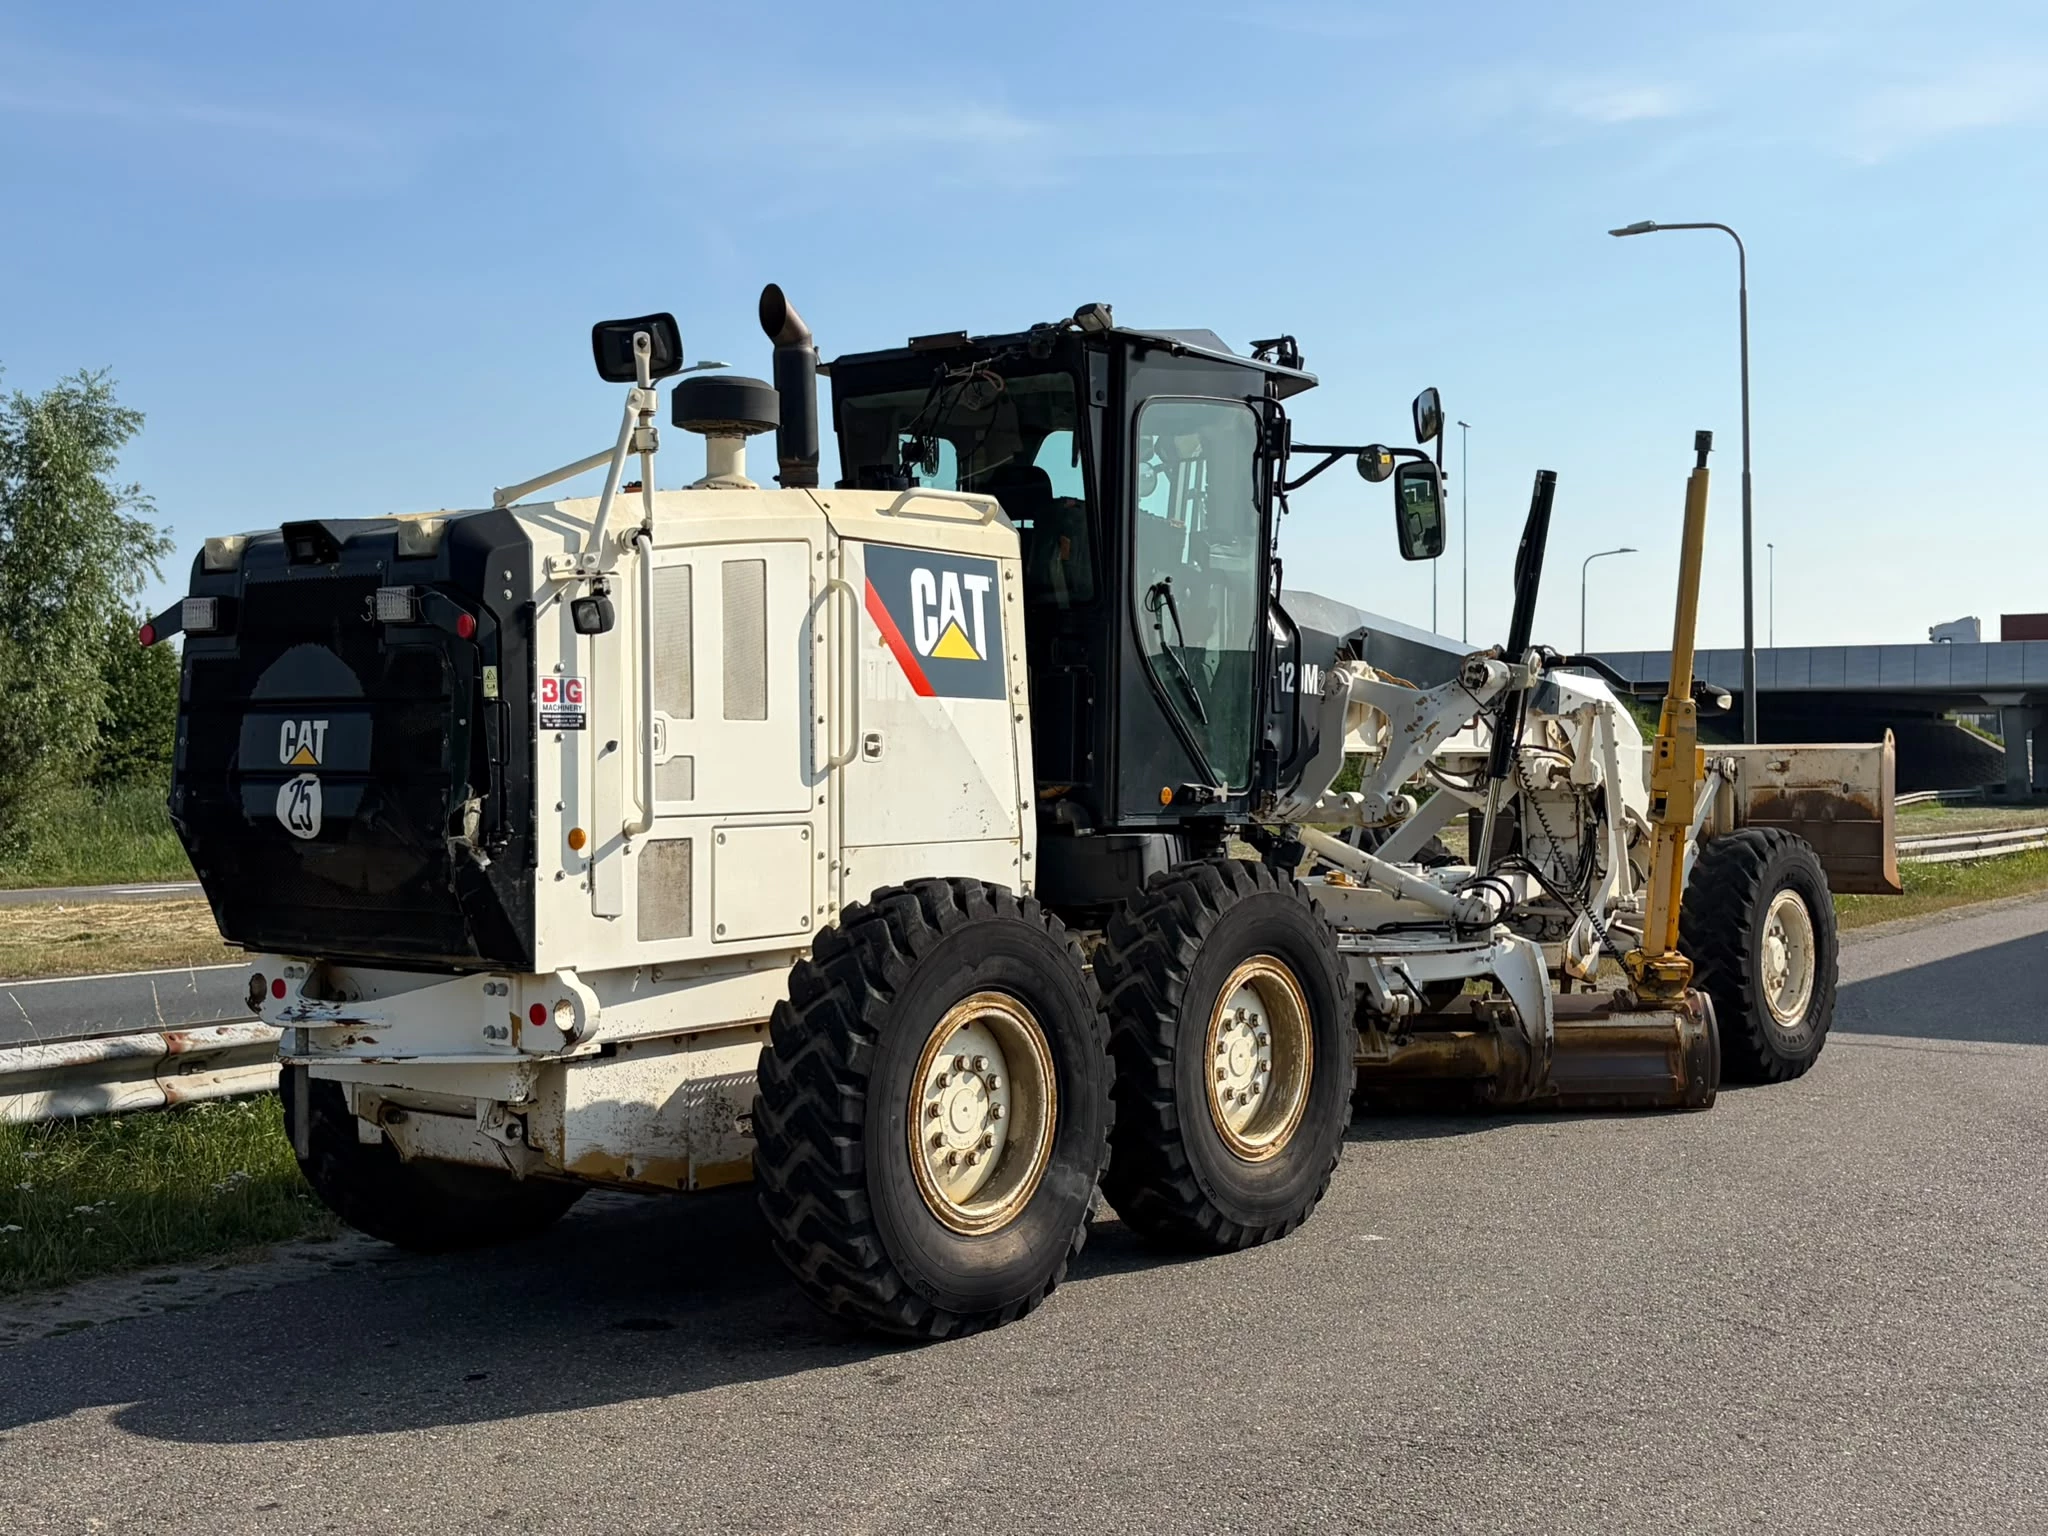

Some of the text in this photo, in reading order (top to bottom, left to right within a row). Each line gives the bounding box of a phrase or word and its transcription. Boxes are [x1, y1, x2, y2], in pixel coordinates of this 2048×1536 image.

[910, 567, 990, 661] CAT
[542, 678, 583, 703] BIG
[542, 704, 583, 712] MACHINERY
[279, 719, 329, 765] CAT
[288, 779, 317, 832] 25
